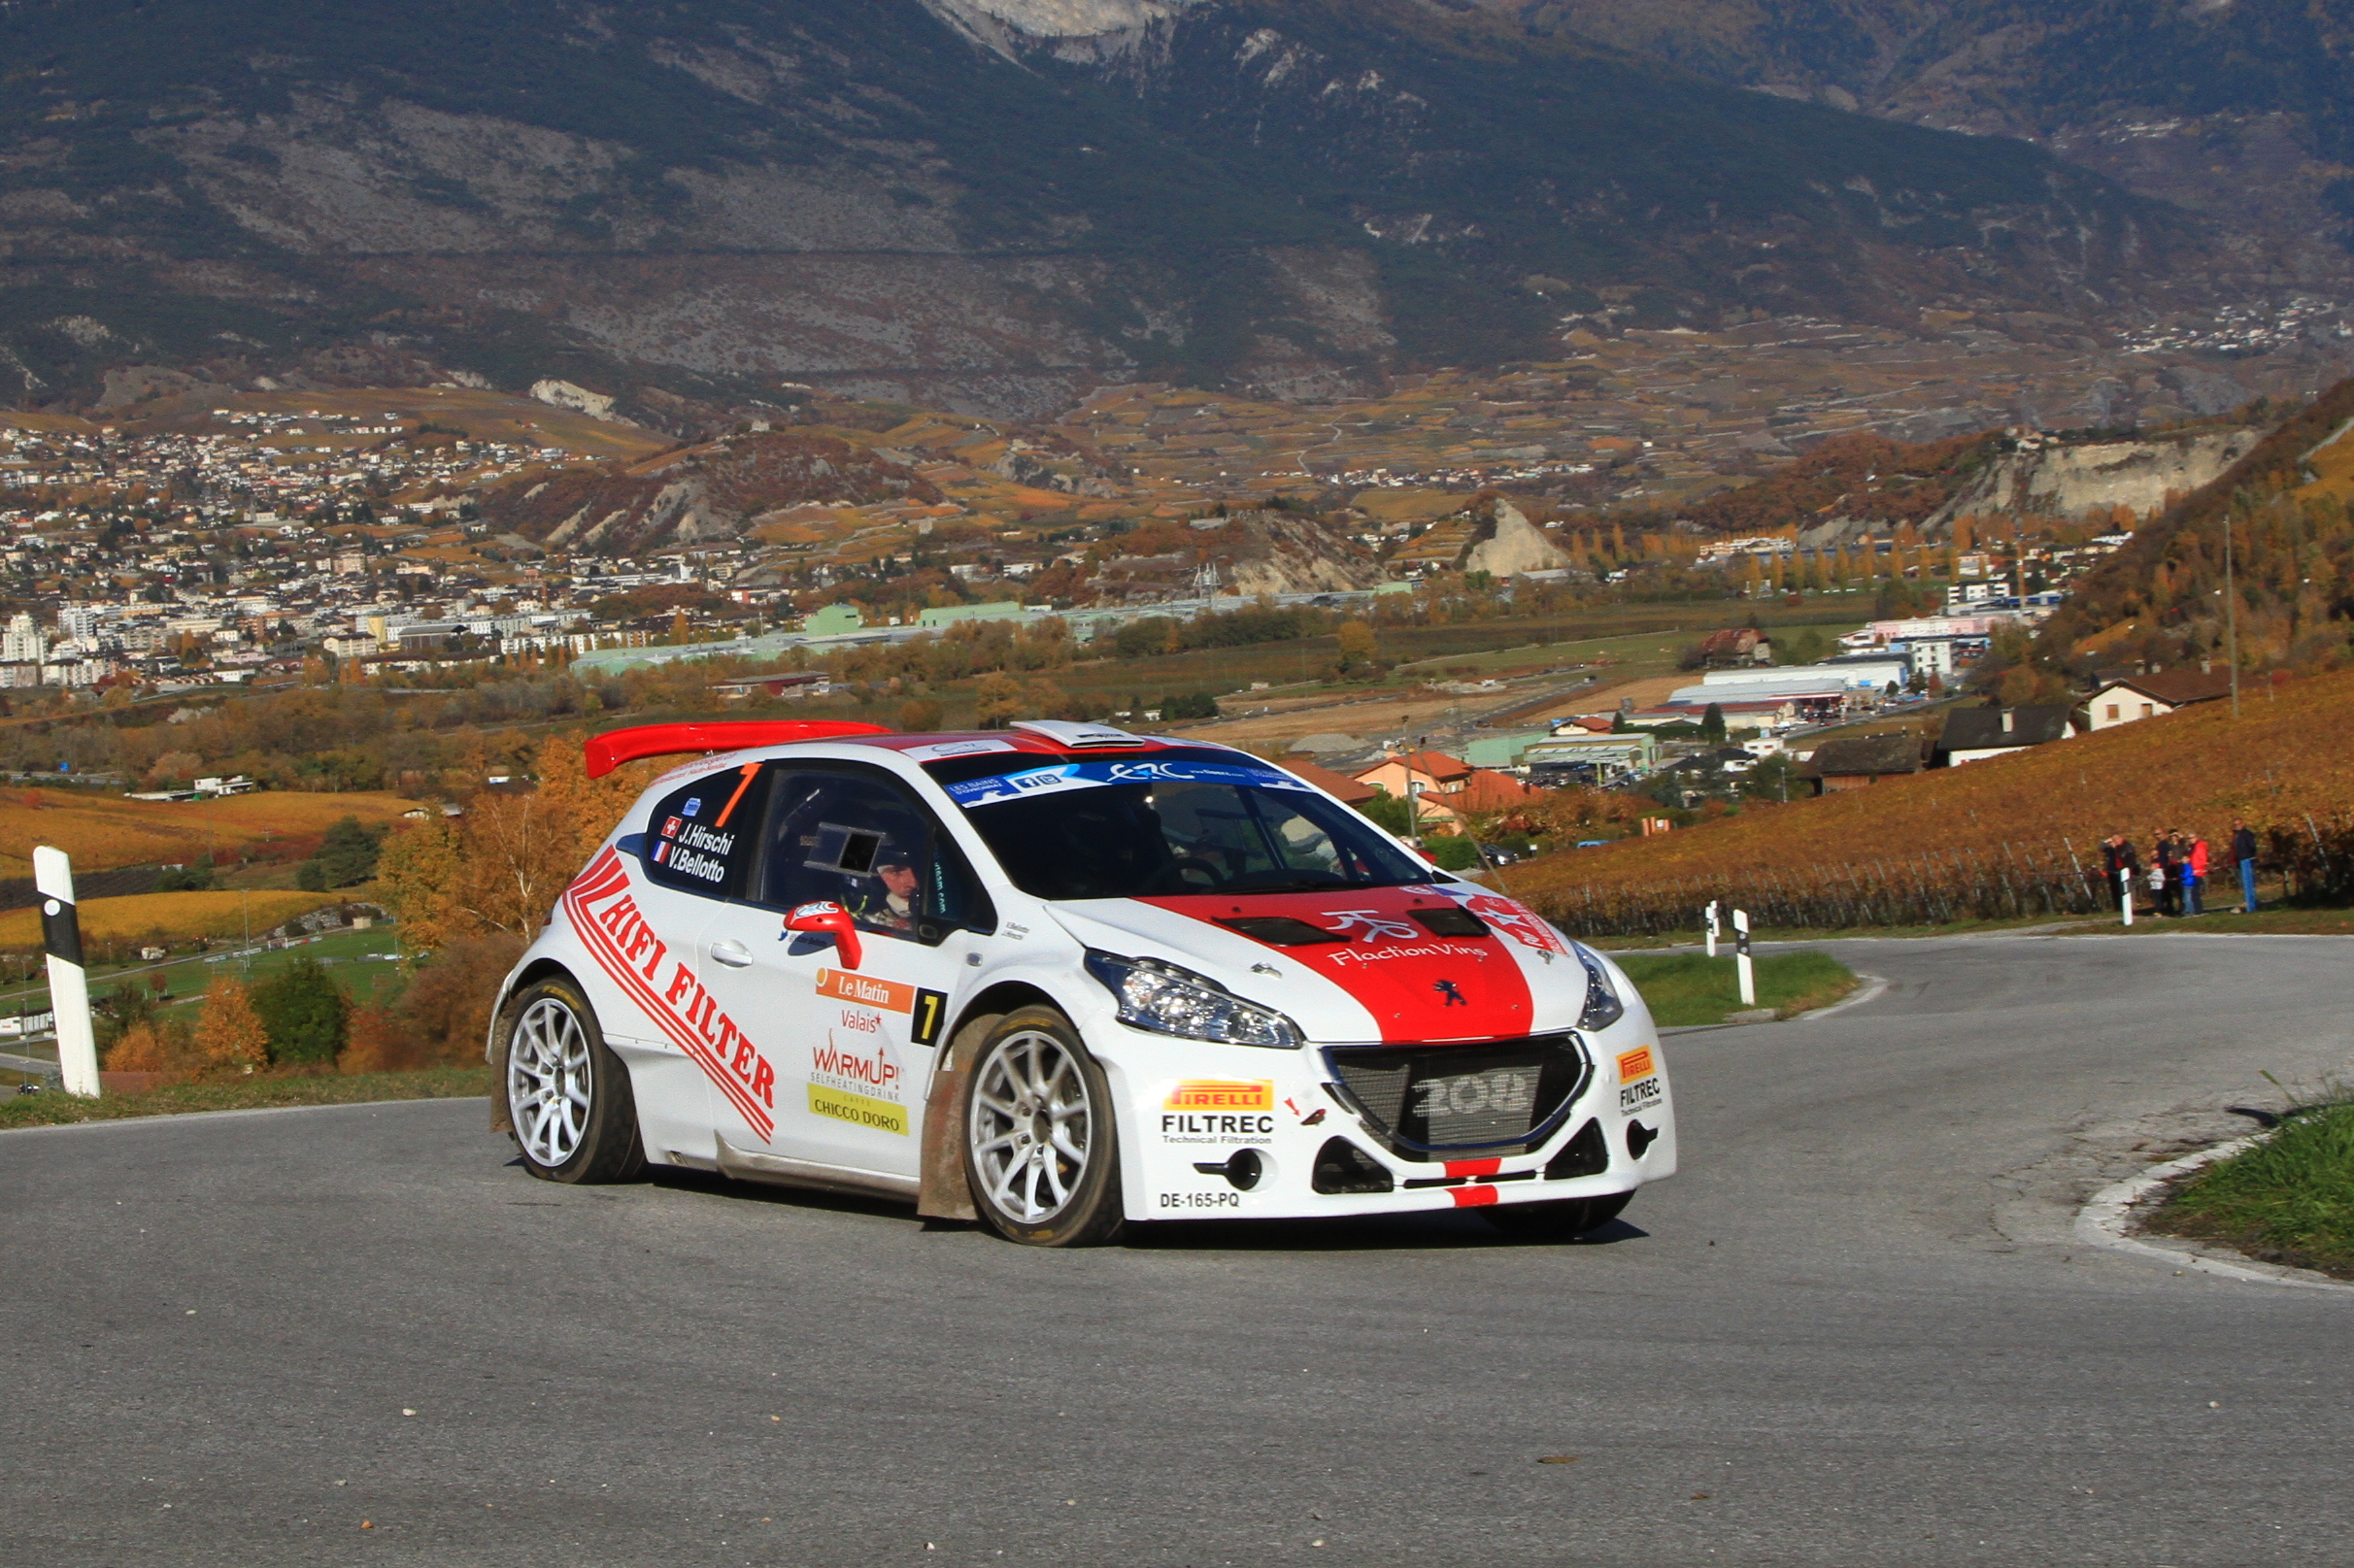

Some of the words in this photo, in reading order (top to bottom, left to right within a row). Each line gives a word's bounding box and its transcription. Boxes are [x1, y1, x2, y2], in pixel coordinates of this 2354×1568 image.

[678, 822, 735, 855] J.Hirschi
[668, 846, 725, 883] V.Bellotto
[1328, 946, 1433, 966] Flaction
[1431, 944, 1488, 956] Vins
[599, 894, 667, 982] HIFI
[664, 961, 776, 1109] FILTER
[838, 976, 854, 995] Le
[854, 979, 891, 1004] Matin
[841, 1010, 877, 1034] Valais
[1171, 1084, 1263, 1106] PIRELLI
[1620, 1077, 1661, 1107] FILTREC
[814, 1099, 859, 1121] CHICCO
[1161, 1115, 1273, 1133] FILTREC
[1162, 1135, 1218, 1144] Technical
[1221, 1135, 1272, 1145] Filtration
[1160, 1192, 1240, 1208] DE-165-PQ
